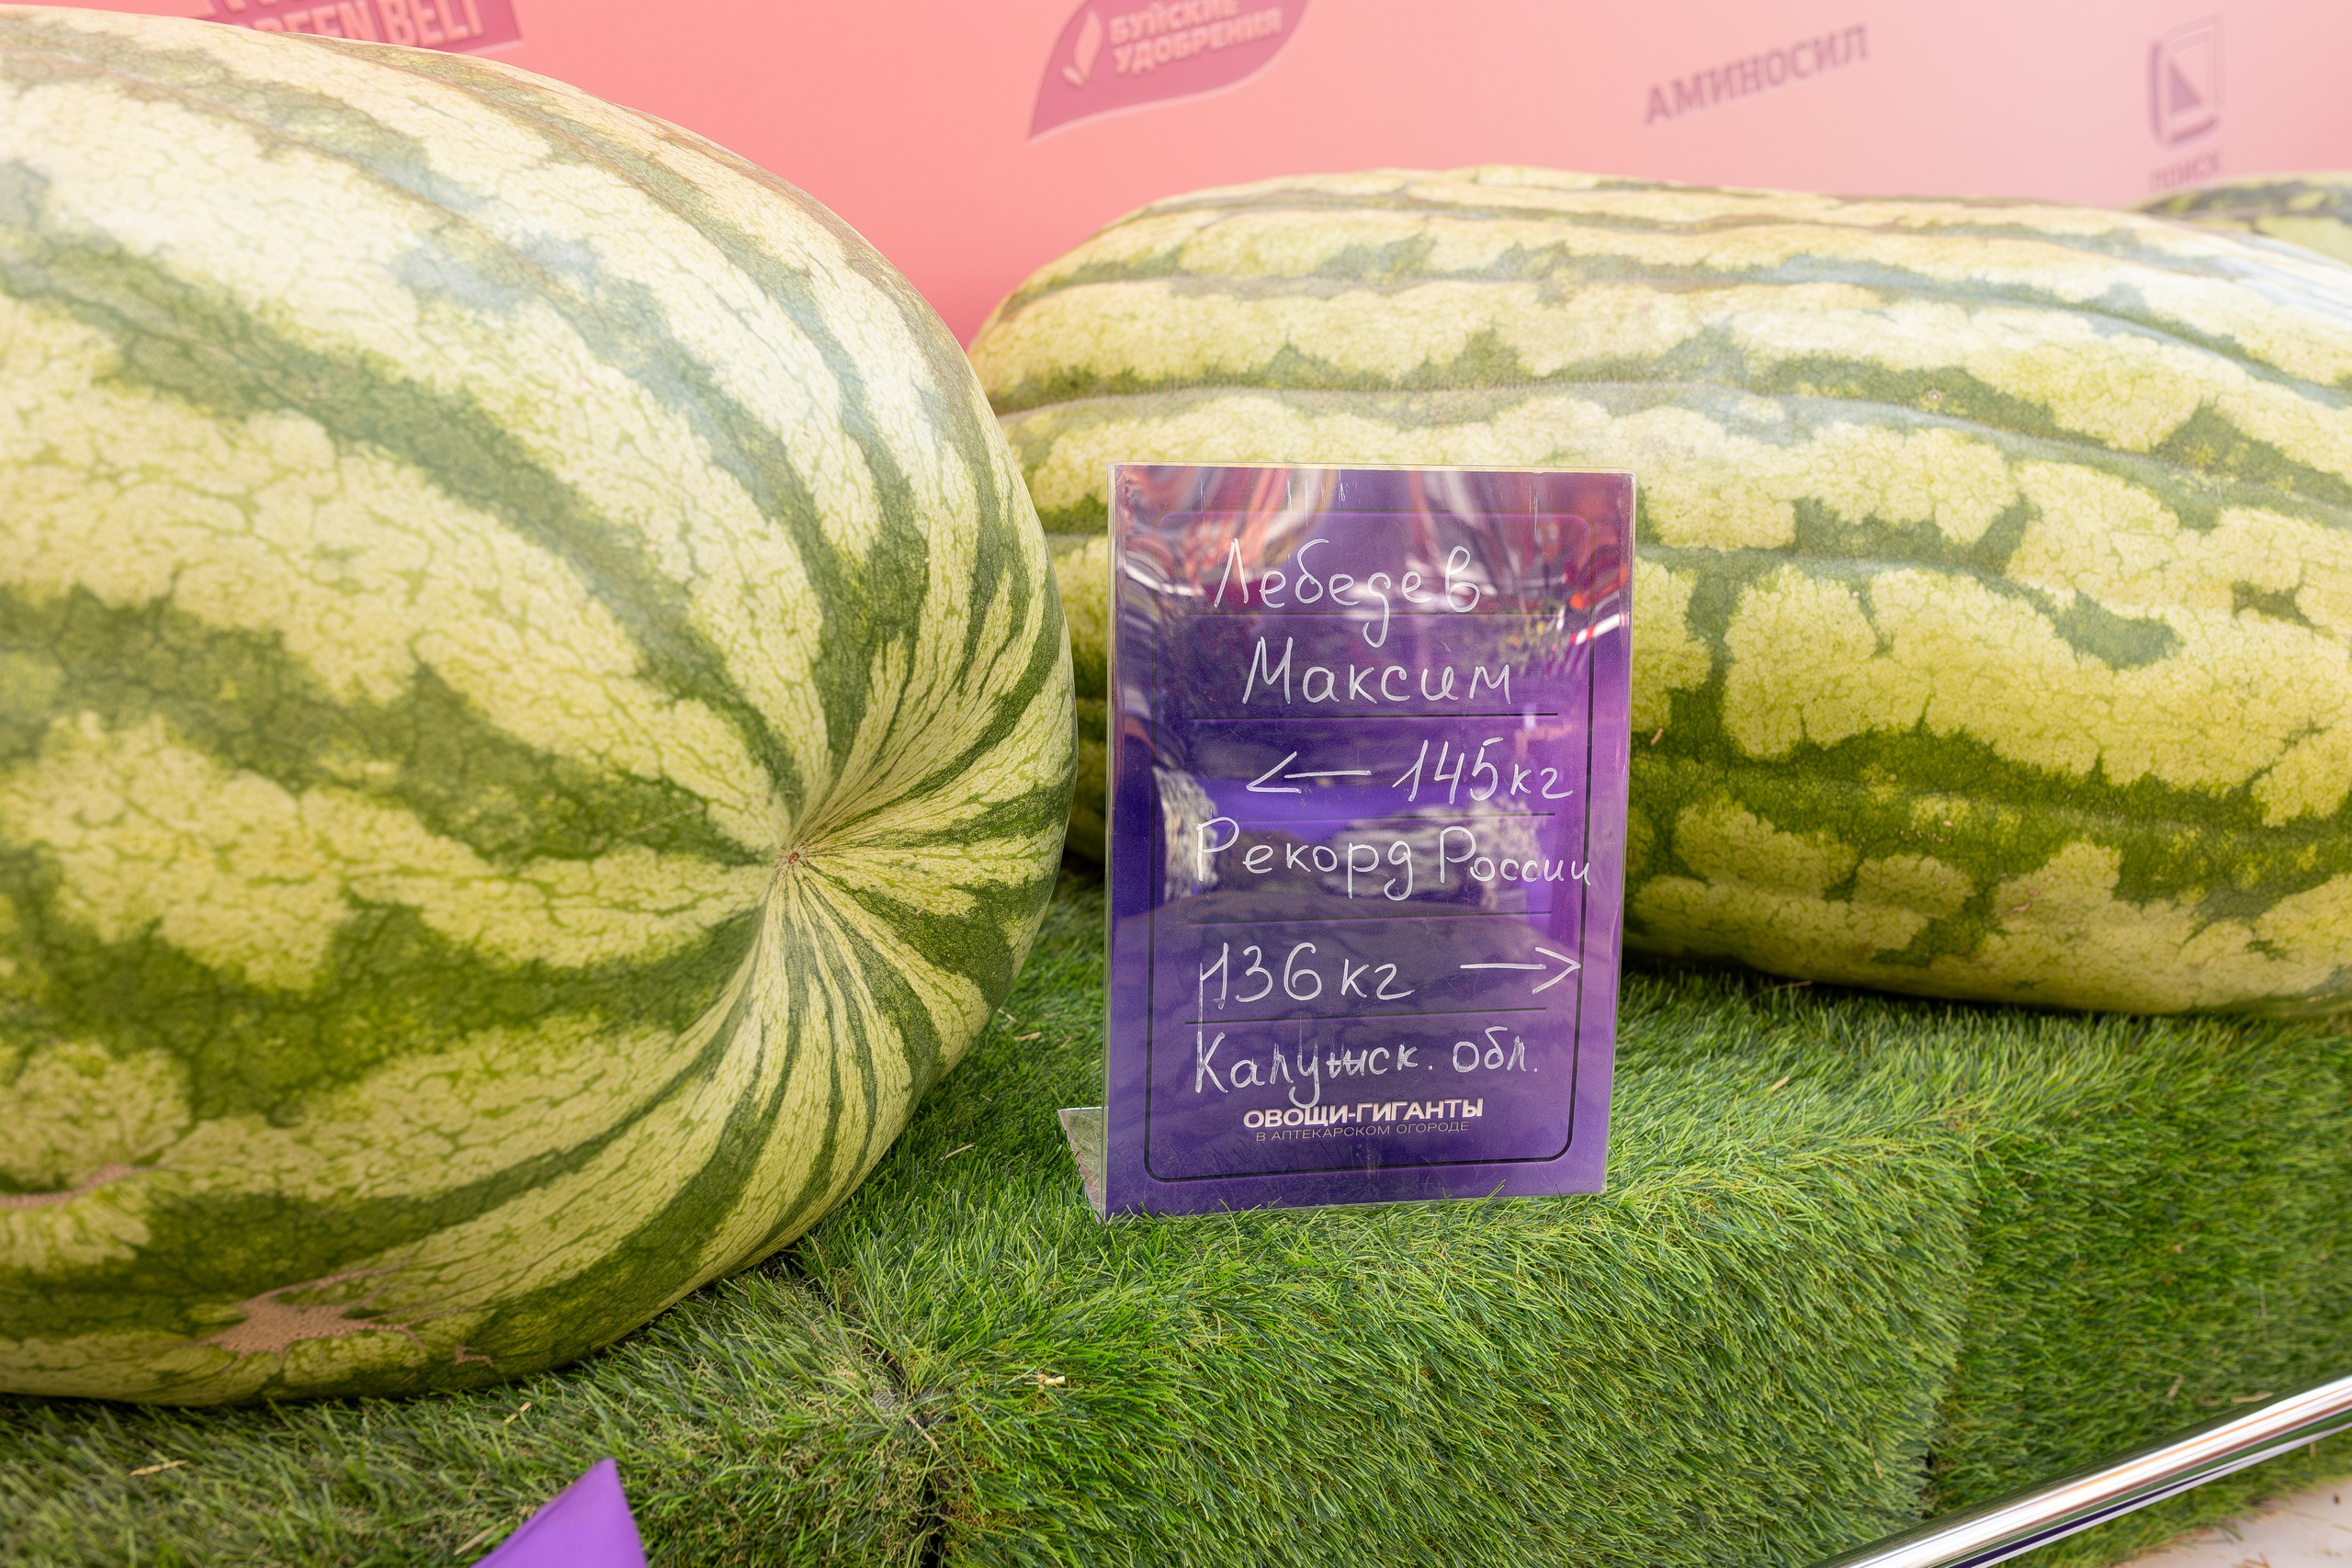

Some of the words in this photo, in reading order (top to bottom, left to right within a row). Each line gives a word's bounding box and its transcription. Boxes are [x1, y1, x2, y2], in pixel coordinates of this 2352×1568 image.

[381, 0, 485, 46] BELT
[1109, 0, 1240, 44] БУЙСКИЕ
[1113, 6, 1283, 74] УДОБРЕНИЯ
[1644, 23, 1870, 125] АМИНОСИЛ
[1214, 537, 1481, 648] Лебедев
[1241, 636, 1511, 705] Максим
[1195, 817, 1413, 901] Рекорд
[1439, 826, 1591, 886] России
[1453, 1026, 1539, 1074] обл.
[1243, 1097, 1484, 1128] ОВОЩИ-ГИГАНТЫ
[1255, 1131, 1266, 1142] В
[1271, 1124, 1390, 1141] АПТЕКАРСКОМ
[1396, 1121, 1470, 1134] ОГОРОДЕ
